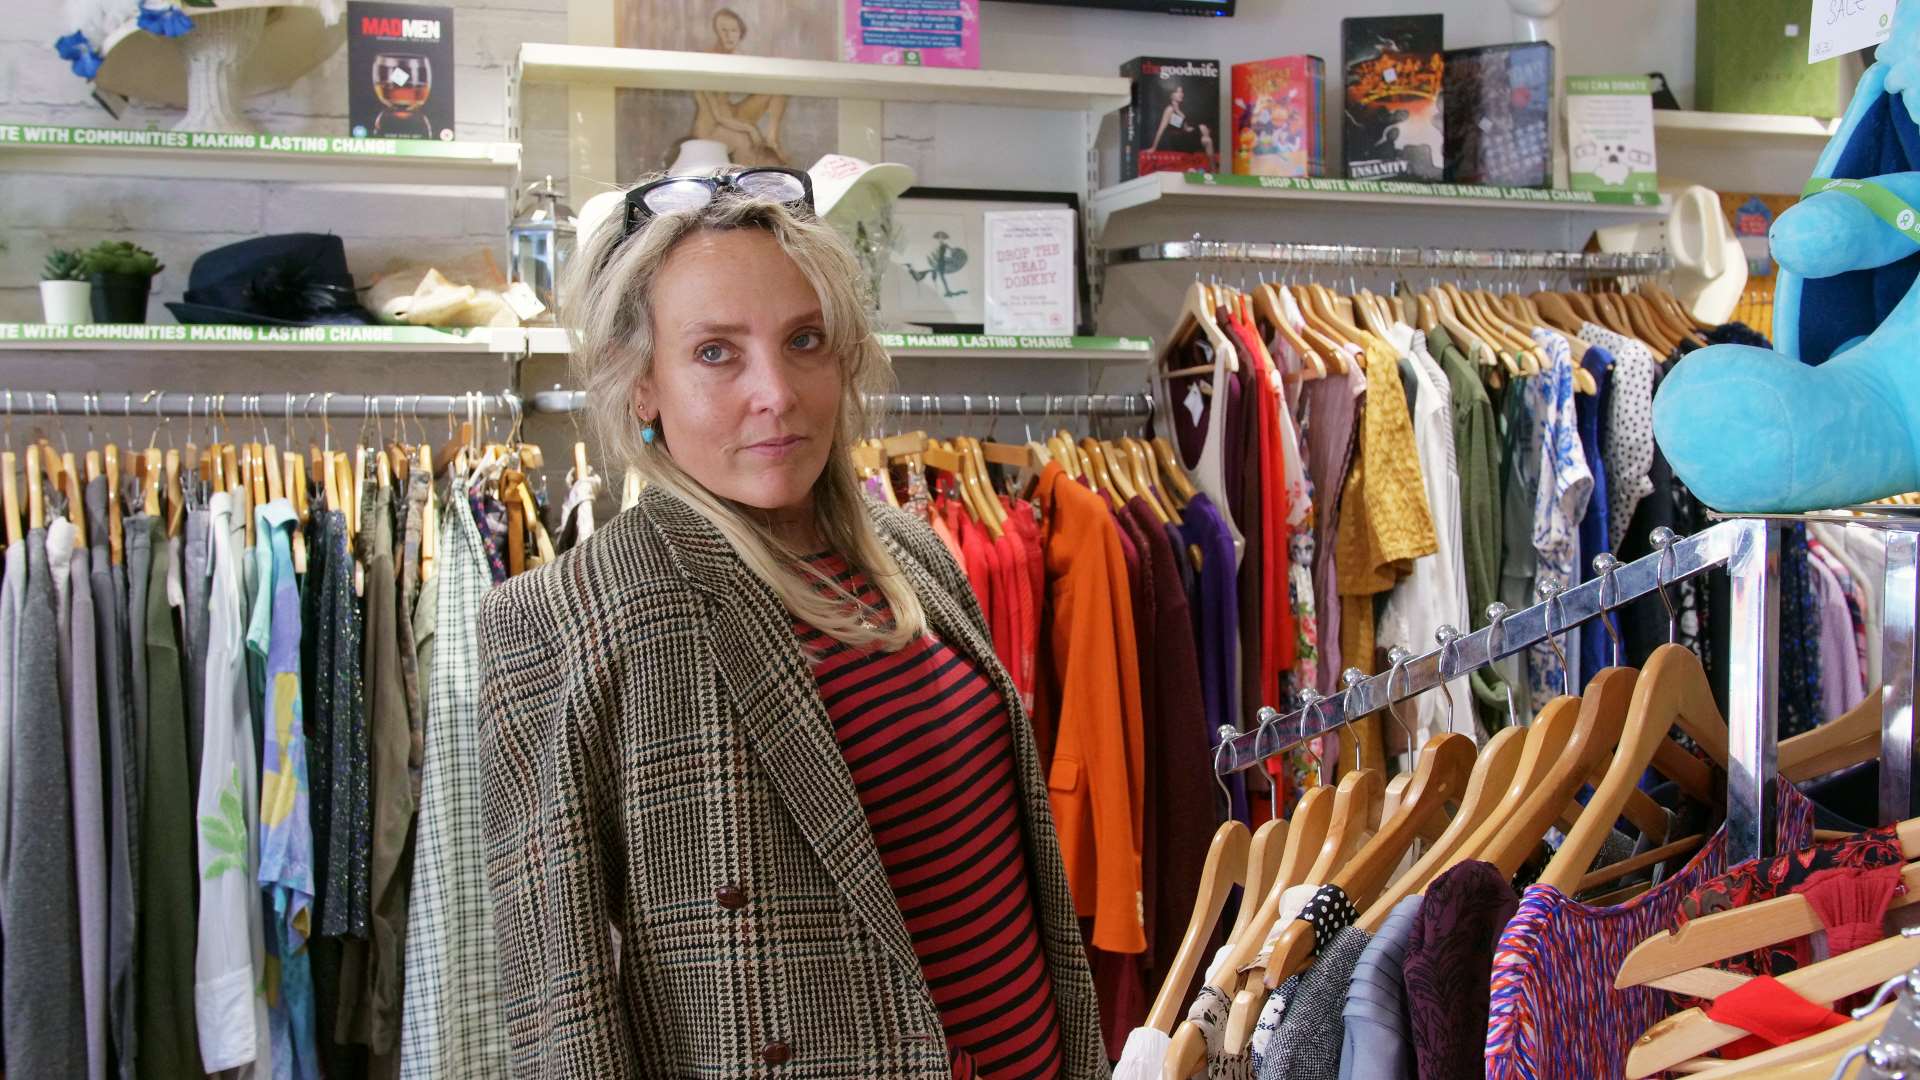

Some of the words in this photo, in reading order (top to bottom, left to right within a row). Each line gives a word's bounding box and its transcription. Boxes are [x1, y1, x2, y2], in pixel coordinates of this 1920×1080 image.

[23, 127, 69, 142] WITH
[74, 129, 188, 147] COMMUNITIES
[192, 133, 255, 148] MAKING
[260, 136, 327, 152] LASTING
[332, 139, 396, 154] CHANGE
[1259, 176, 1291, 188] SHOP
[1295, 178, 1308, 189] TO
[1312, 179, 1346, 191] UNITE
[1348, 179, 1380, 192] WITH
[1382, 182, 1457, 197] COMMUNITIES
[1459, 186, 1501, 199] MAKING
[1502, 188, 1550, 201] LASTING
[1551, 191, 1596, 203] CHANGE
[997, 248, 1030, 262] DROP
[1033, 244, 1060, 258] THE
[1012, 259, 1048, 273] DEAD
[1004, 271, 1057, 289] DONKEY
[23, 325, 68, 339] WITH
[73, 324, 186, 340] COMMUNITIES
[190, 325, 251, 341] MAKING
[258, 327, 325, 341] LASTING
[330, 328, 394, 342] CHANGE
[907, 335, 958, 347] MAKING
[962, 336, 1017, 348] LASTING
[1020, 337, 1073, 348] CHANGE
